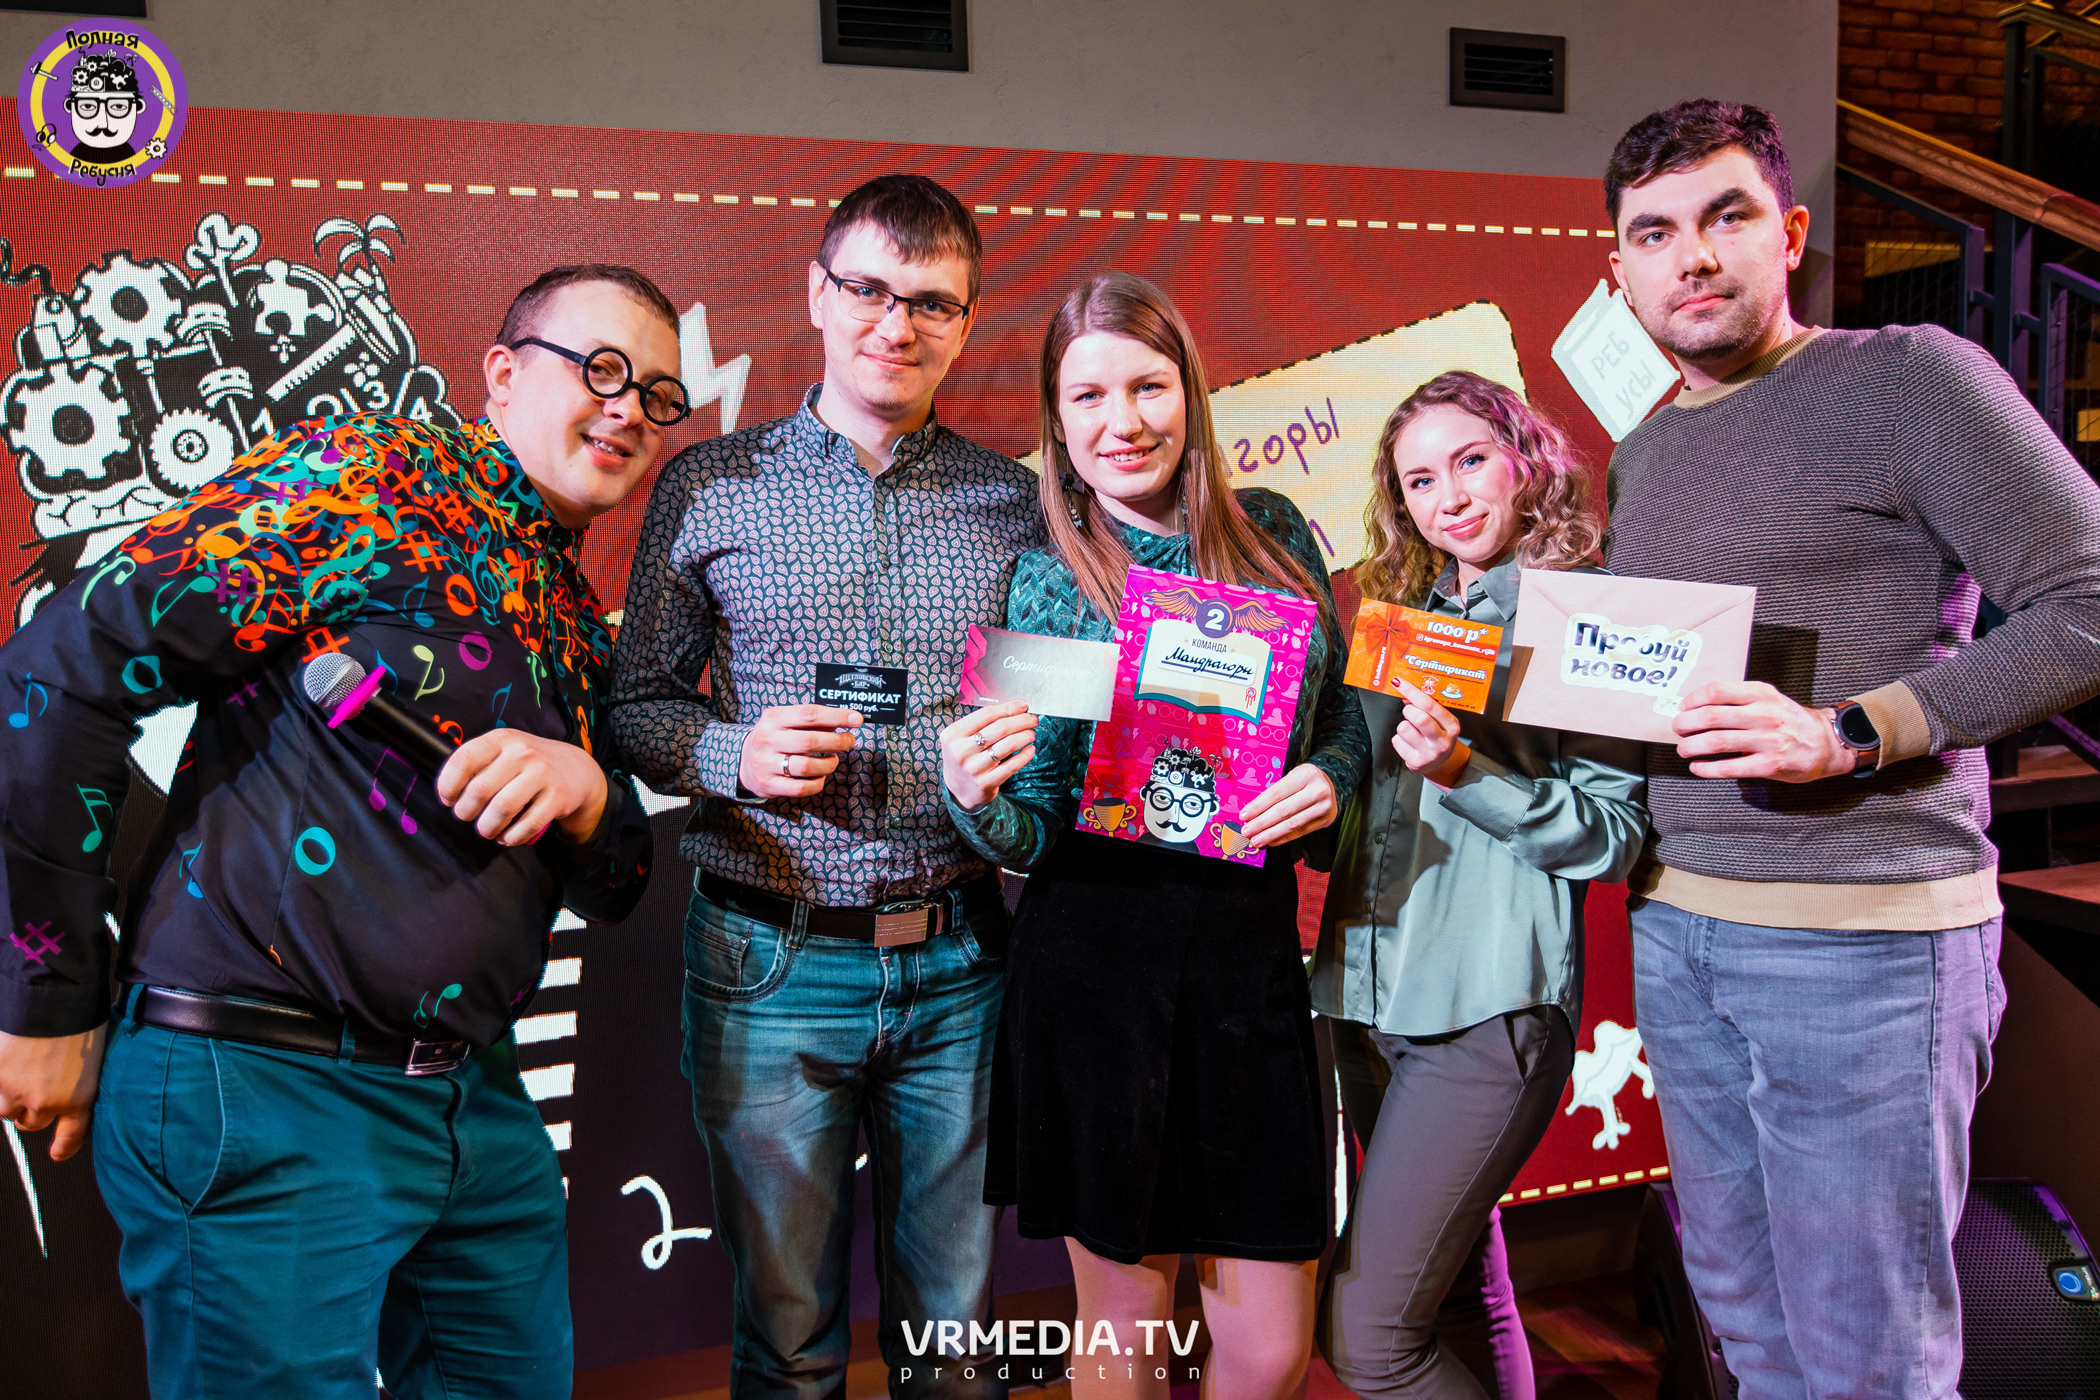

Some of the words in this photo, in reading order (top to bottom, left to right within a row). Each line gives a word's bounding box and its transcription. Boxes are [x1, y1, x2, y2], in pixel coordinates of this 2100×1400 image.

[1204, 608, 1225, 631] 2
[1426, 621, 1464, 638] 1000
[1191, 638, 1228, 653] КОМАНДА
[1571, 648, 1678, 688] новое!
[819, 688, 901, 704] СЕРТИФИКАТ
[849, 703, 863, 711] 500
[863, 705, 879, 713] руб.
